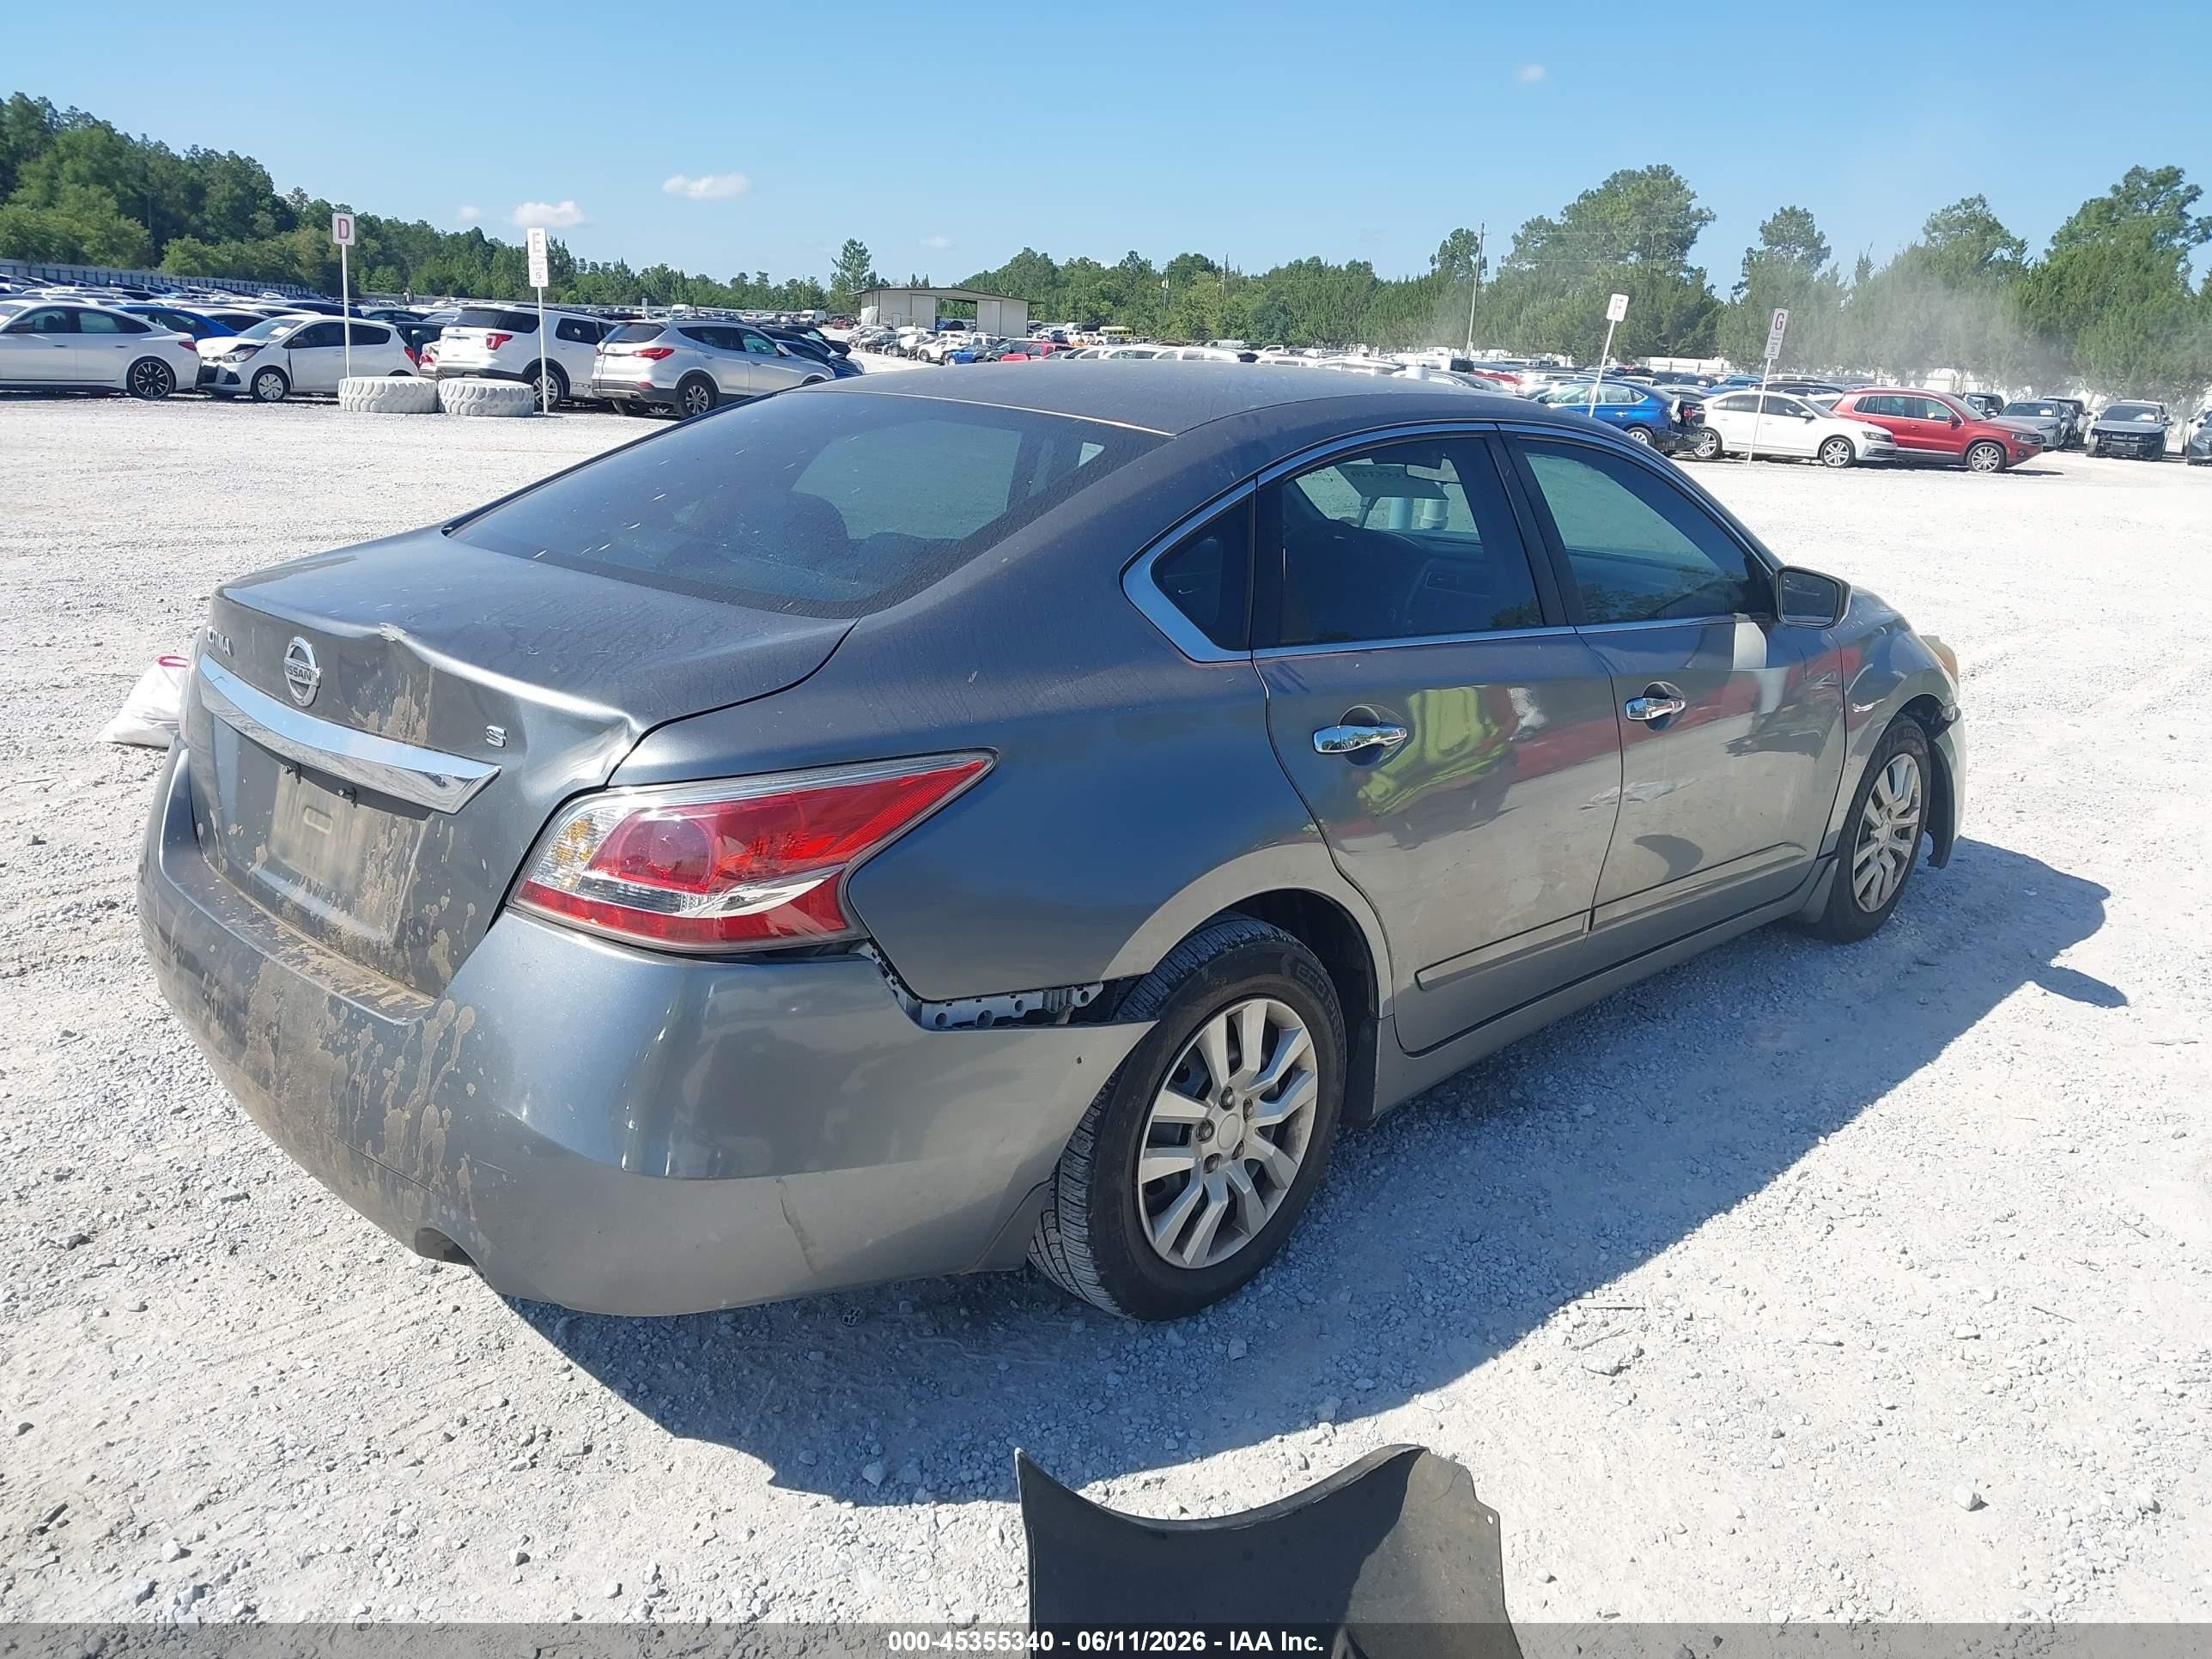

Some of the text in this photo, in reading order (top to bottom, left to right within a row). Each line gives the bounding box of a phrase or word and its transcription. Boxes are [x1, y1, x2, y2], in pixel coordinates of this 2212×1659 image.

[337, 218, 350, 240] D
[532, 232, 542, 253] E
[1612, 298, 1624, 316] F
[1774, 313, 1785, 331] G
[485, 725, 507, 748] S
